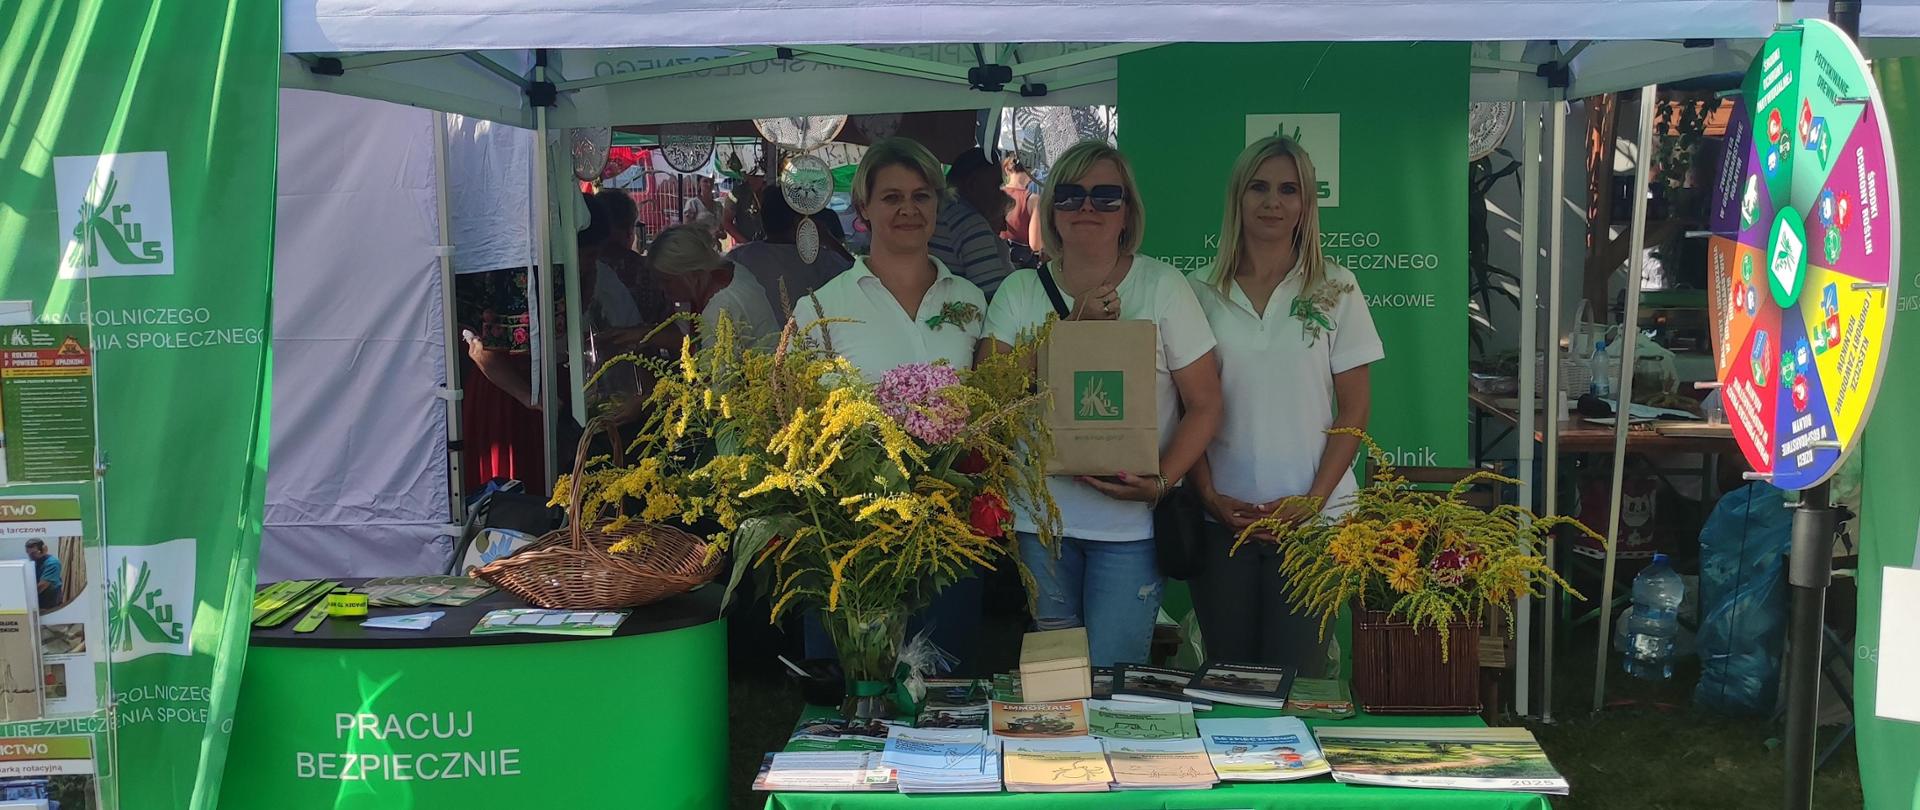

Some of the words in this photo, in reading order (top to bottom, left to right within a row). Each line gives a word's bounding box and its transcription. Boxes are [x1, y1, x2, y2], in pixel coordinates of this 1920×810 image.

[1856, 147, 1869, 205] OCHRONY
[1866, 170, 1878, 219] ŚRODKI
[1319, 233, 1380, 247] CZEGO
[1861, 207, 1873, 255] ROŚLIN
[1365, 295, 1436, 307] RAKOWIE
[1854, 299, 1870, 351] CHOROBY
[1837, 315, 1855, 375] ROLNIKÓW
[1852, 336, 1869, 393] KLESZCZE
[1835, 352, 1856, 416] ZAWODOWE
[335, 711, 473, 739] PRACUJ
[23, 765, 62, 773] rotacyjną
[296, 748, 521, 780] BEZPIECZNIE
[1510, 779, 1555, 787] 2025
